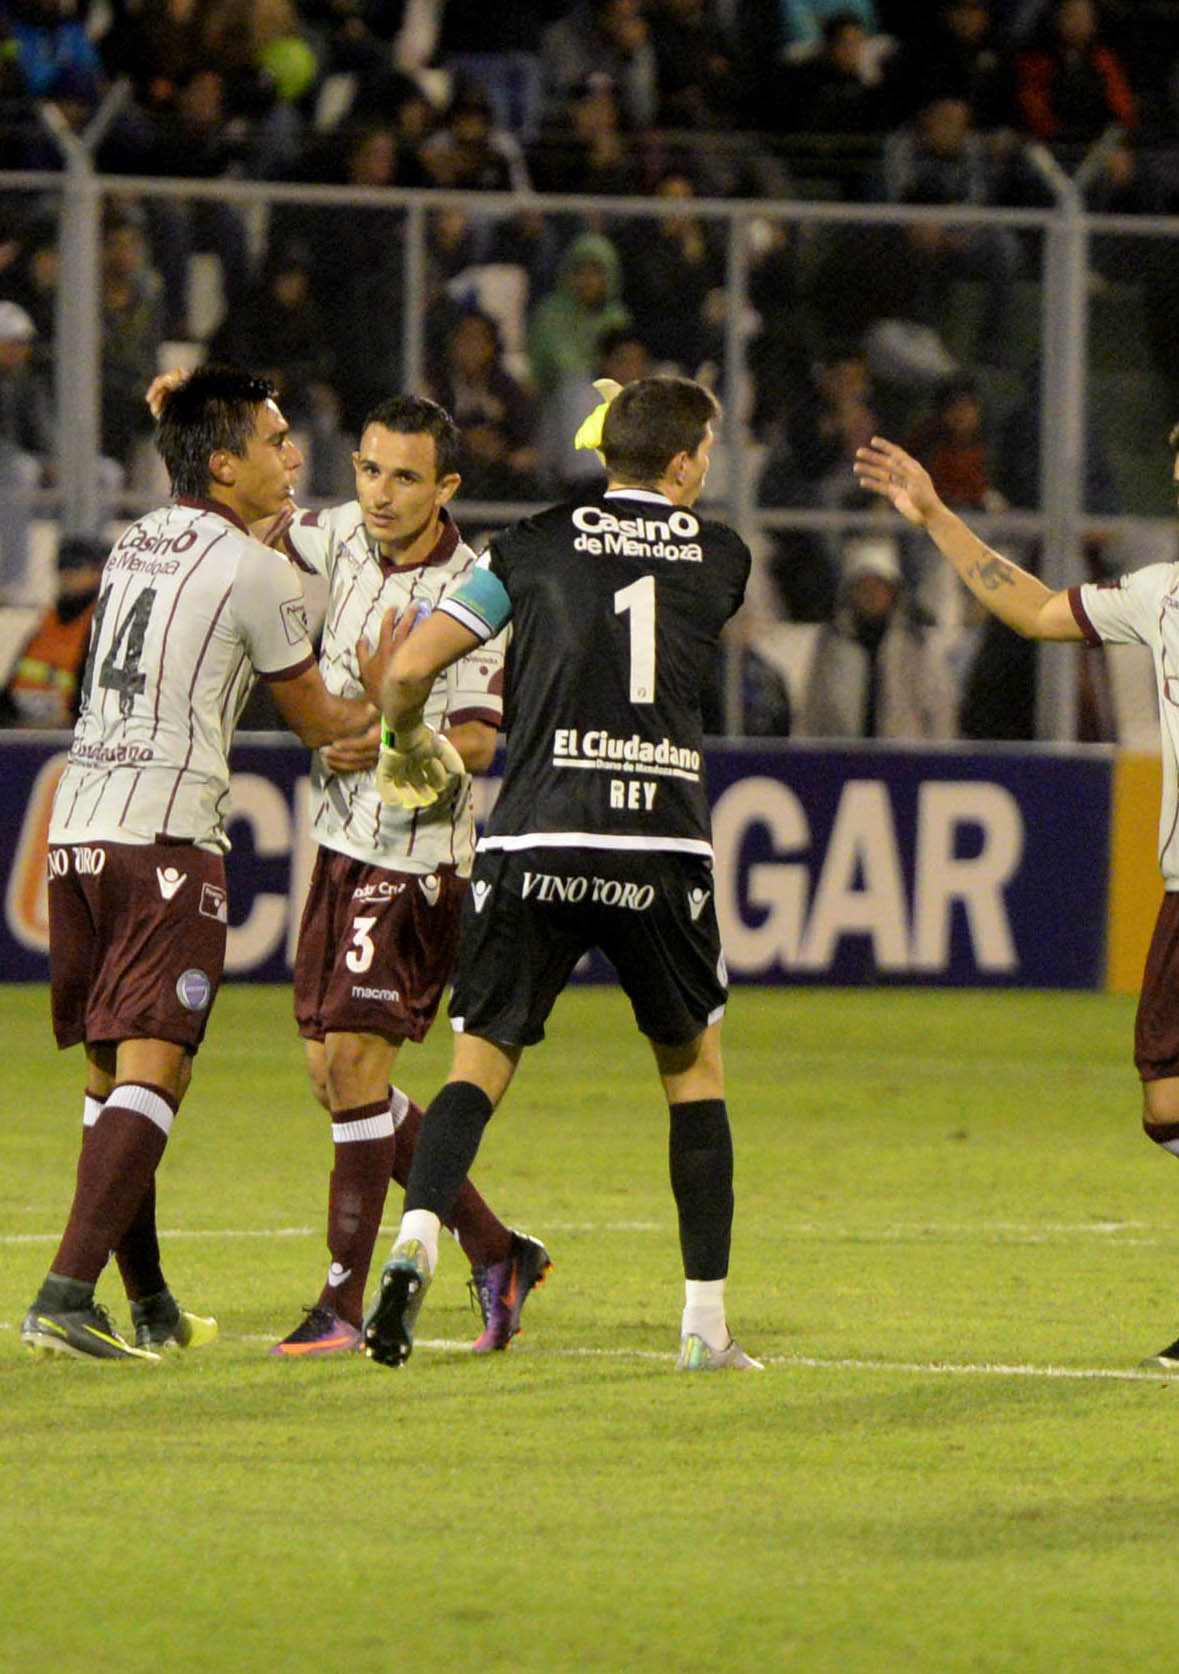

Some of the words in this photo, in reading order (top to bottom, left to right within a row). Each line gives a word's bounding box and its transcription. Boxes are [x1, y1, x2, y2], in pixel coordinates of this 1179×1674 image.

[573, 533, 603, 556] de
[605, 533, 703, 563] Mendoza
[81, 582, 158, 717] 14
[614, 575, 656, 704] 1
[553, 729, 578, 757] El
[582, 730, 700, 771] Ciudadano
[610, 779, 657, 810] REY
[522, 872, 588, 903] VINO
[591, 875, 655, 911] TORO
[346, 917, 377, 973] 3
